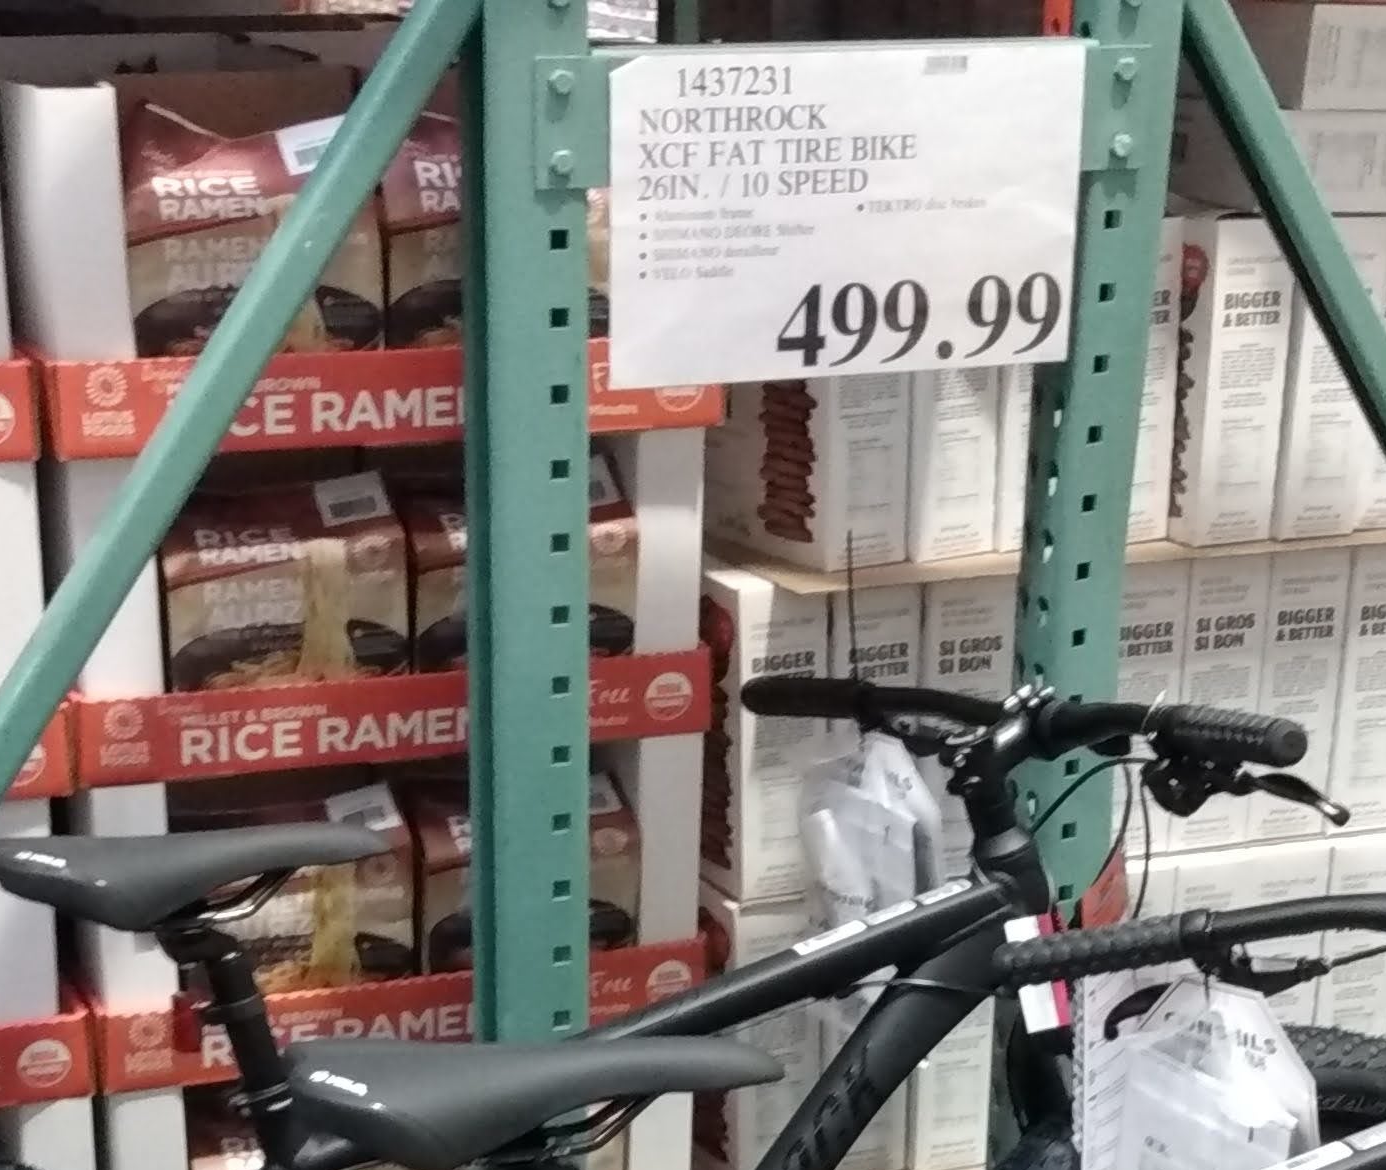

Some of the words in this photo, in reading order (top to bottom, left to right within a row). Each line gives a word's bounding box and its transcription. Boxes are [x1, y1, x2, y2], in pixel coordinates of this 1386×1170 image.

[677, 66, 793, 97] 1437231
[638, 104, 828, 135] NORTHROCK
[638, 142, 700, 169] XCF
[708, 140, 765, 167] FAT
[775, 137, 843, 165] TIRE
[850, 134, 919, 162] BIKE
[151, 175, 261, 197] RICE
[637, 174, 710, 201] 26IN.
[741, 172, 769, 198] 10
[777, 168, 869, 196] SPEED
[159, 196, 271, 221] RAMEN
[1223, 290, 1283, 312] BIGGER
[776, 272, 1062, 369] 499.99
[1234, 311, 1282, 328] BETTER
[252, 376, 322, 394] ROWN
[311, 386, 465, 434] RAME
[194, 526, 295, 549] RICE
[1196, 616, 1212, 634] SI
[1214, 613, 1256, 631] GROS
[1277, 606, 1335, 626] BIGGER
[1194, 634, 1210, 652] SI
[1213, 632, 1245, 650] BON
[1289, 625, 1334, 642] BETTER
[939, 639, 956, 657] SI
[959, 635, 1003, 654] GROS
[1126, 640, 1174, 658] BETTER
[751, 651, 817, 674] BIGGER
[938, 659, 955, 676] SI
[958, 655, 992, 673] BON
[179, 720, 305, 768] RICE
